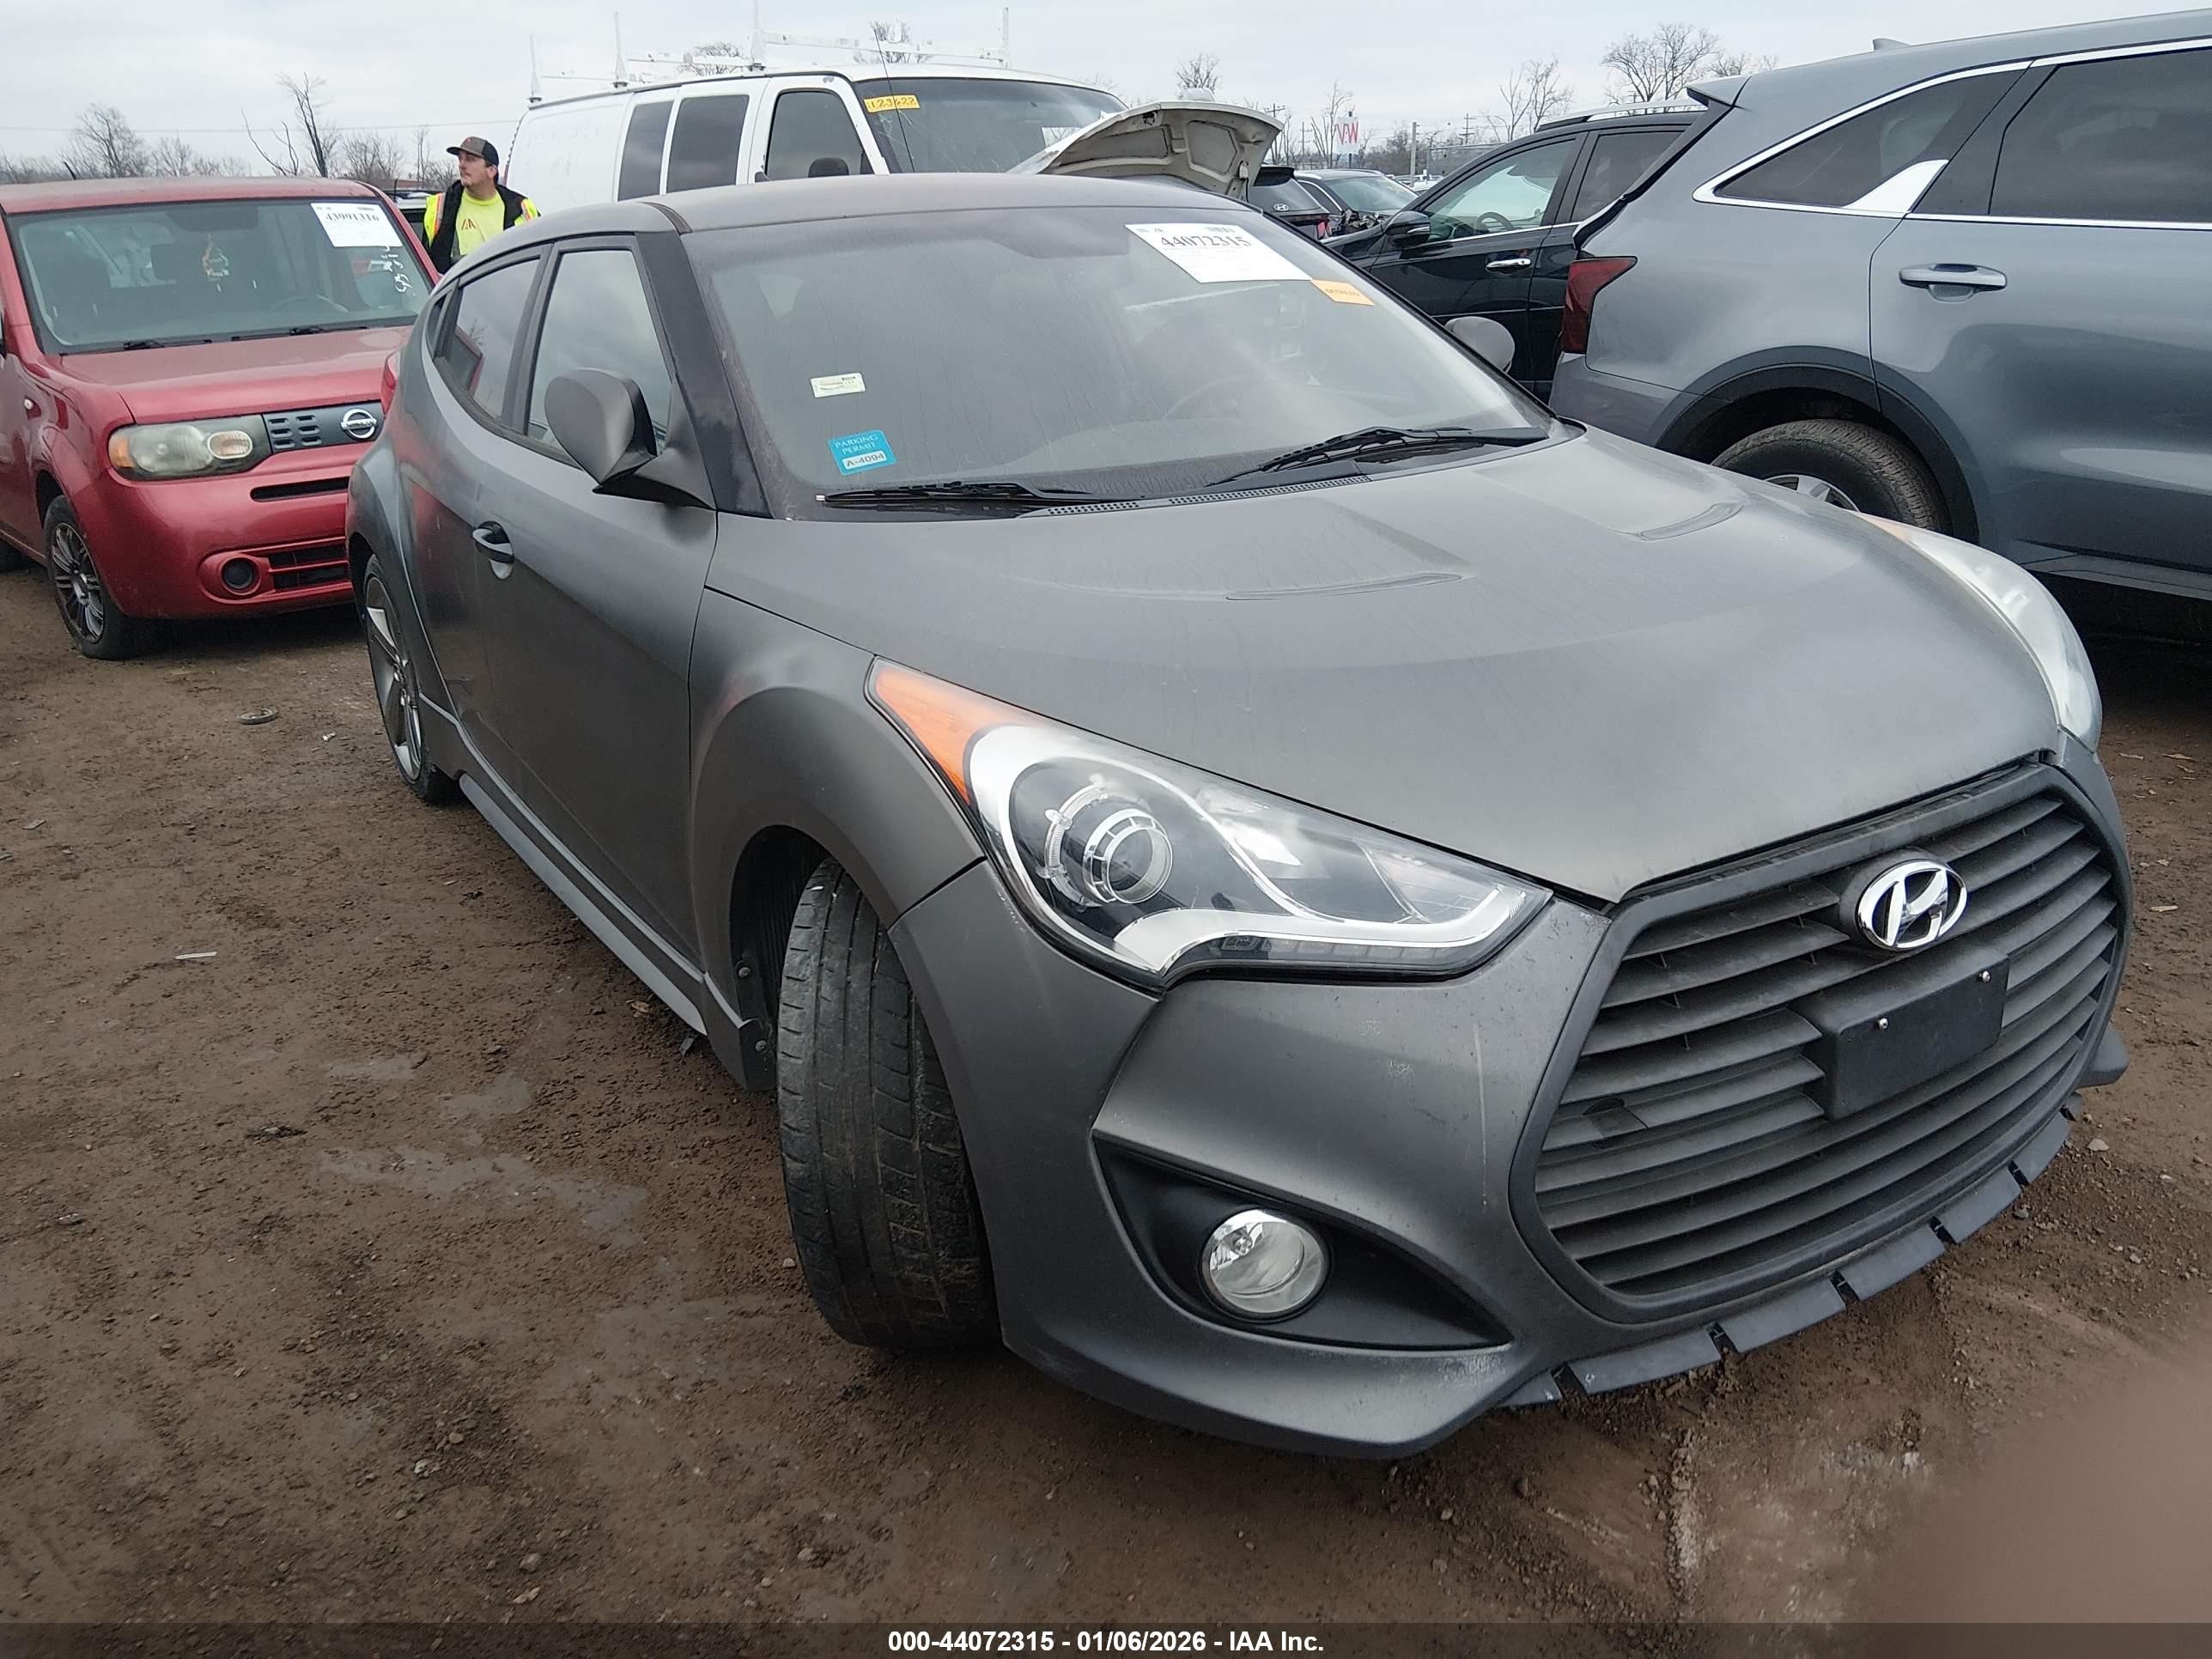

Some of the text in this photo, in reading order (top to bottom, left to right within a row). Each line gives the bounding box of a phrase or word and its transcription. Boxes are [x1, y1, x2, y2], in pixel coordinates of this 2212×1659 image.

[1161, 235, 1252, 247] 44072315
[835, 434, 878, 448] PARKING
[842, 441, 877, 454] PERMIT
[847, 453, 884, 467] A-4094
